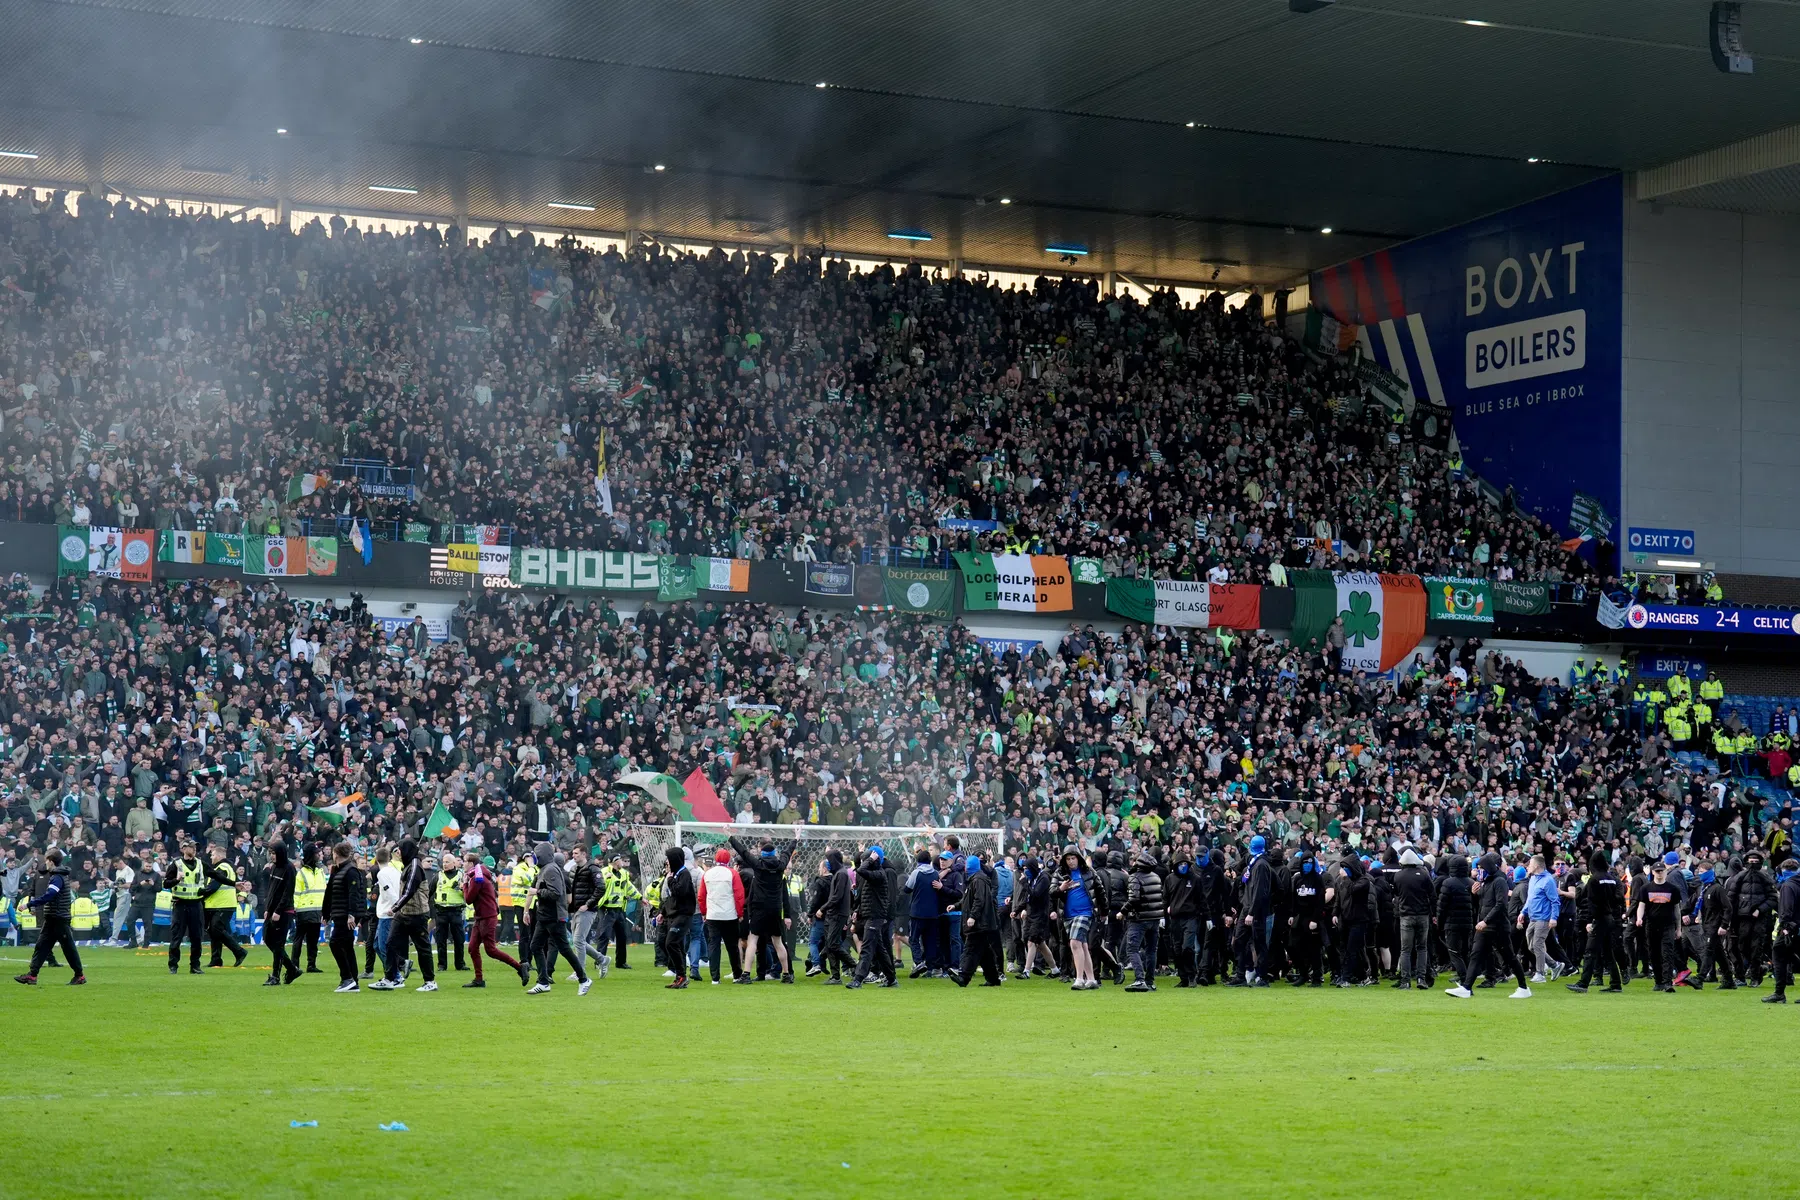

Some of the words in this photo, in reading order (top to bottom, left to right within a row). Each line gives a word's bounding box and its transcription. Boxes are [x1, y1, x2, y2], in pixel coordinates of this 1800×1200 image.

[1466, 241, 1585, 317] BOXT
[1475, 325, 1576, 373] BOILERS
[1466, 400, 1493, 416] BLUE
[1499, 396, 1521, 411] SEA
[1526, 392, 1542, 405] OF
[1547, 384, 1585, 402] IBROX
[373, 484, 396, 496] EMERALD
[972, 525, 980, 538] 5
[1644, 534, 1670, 547] EXIT
[1673, 536, 1680, 547] 7
[448, 548, 510, 563] BAILLIESTON
[520, 548, 660, 588] BHOYS
[430, 577, 464, 586] HOUSE
[482, 576, 522, 589] GROU
[966, 573, 1066, 586] LOCHGILPHEAD
[1131, 579, 1151, 589] TOM
[1155, 581, 1205, 593] WILLIAMS
[1352, 574, 1417, 588] SHAMROCK
[985, 592, 1048, 603] EMERALD
[1145, 598, 1171, 610] PORT
[1175, 601, 1224, 613] GLASGOW
[1648, 612, 1699, 625] RANGERS
[1715, 610, 1740, 628] 2-4
[1752, 616, 1790, 629] CELTIC
[987, 641, 1011, 653] EXIT
[1016, 642, 1023, 654] 5
[1656, 660, 1680, 671] EXIT
[1683, 660, 1690, 672] 7
